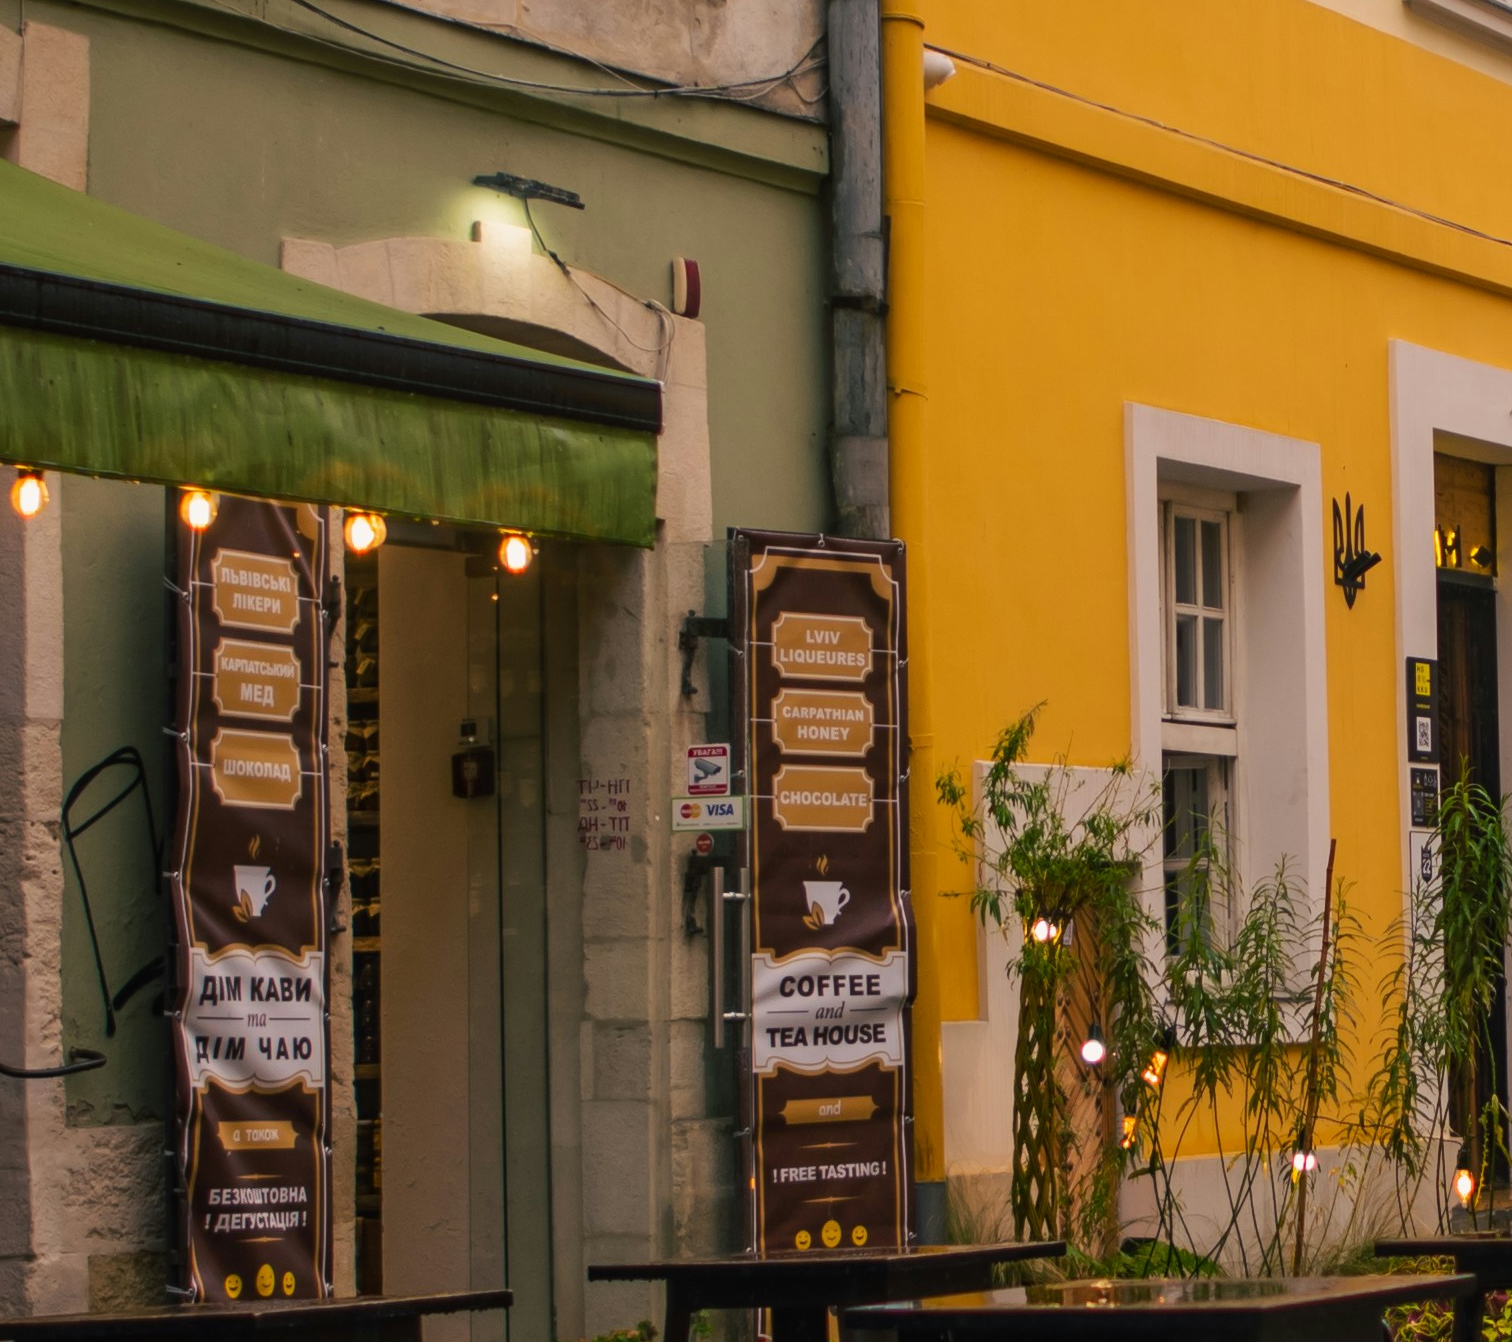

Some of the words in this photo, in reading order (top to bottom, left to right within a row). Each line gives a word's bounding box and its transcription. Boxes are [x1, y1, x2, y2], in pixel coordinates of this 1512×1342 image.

[220, 567, 291, 593] ЛЬВІВСЬКІ
[232, 592, 281, 614] ЛІКЕРИ
[806, 629, 840, 645] LVIV
[780, 648, 865, 666] LIQUEURES
[220, 657, 295, 678] КАРПАТСЬКИЙ
[240, 684, 274, 707] МЕД
[782, 706, 864, 721] CARPATHIAN
[797, 726, 850, 741] HONEY
[224, 759, 291, 782] ШОКОЛАД
[780, 790, 867, 807] CHOCOLATE
[706, 804, 734, 816] VISA
[199, 976, 241, 1006] ДІМ
[250, 976, 312, 1002] КАВИ
[779, 974, 880, 997] COFFEE
[815, 1001, 845, 1020] and
[766, 1027, 808, 1048] TEA
[813, 1023, 886, 1046] HOUSE
[196, 1036, 246, 1063] ДІМ
[259, 1037, 312, 1060] ЧАЮ
[818, 1100, 841, 1116] and
[233, 1131, 241, 1142] а
[246, 1130, 279, 1142] також
[208, 1186, 308, 1206] БЕЗКОШТОВНА
